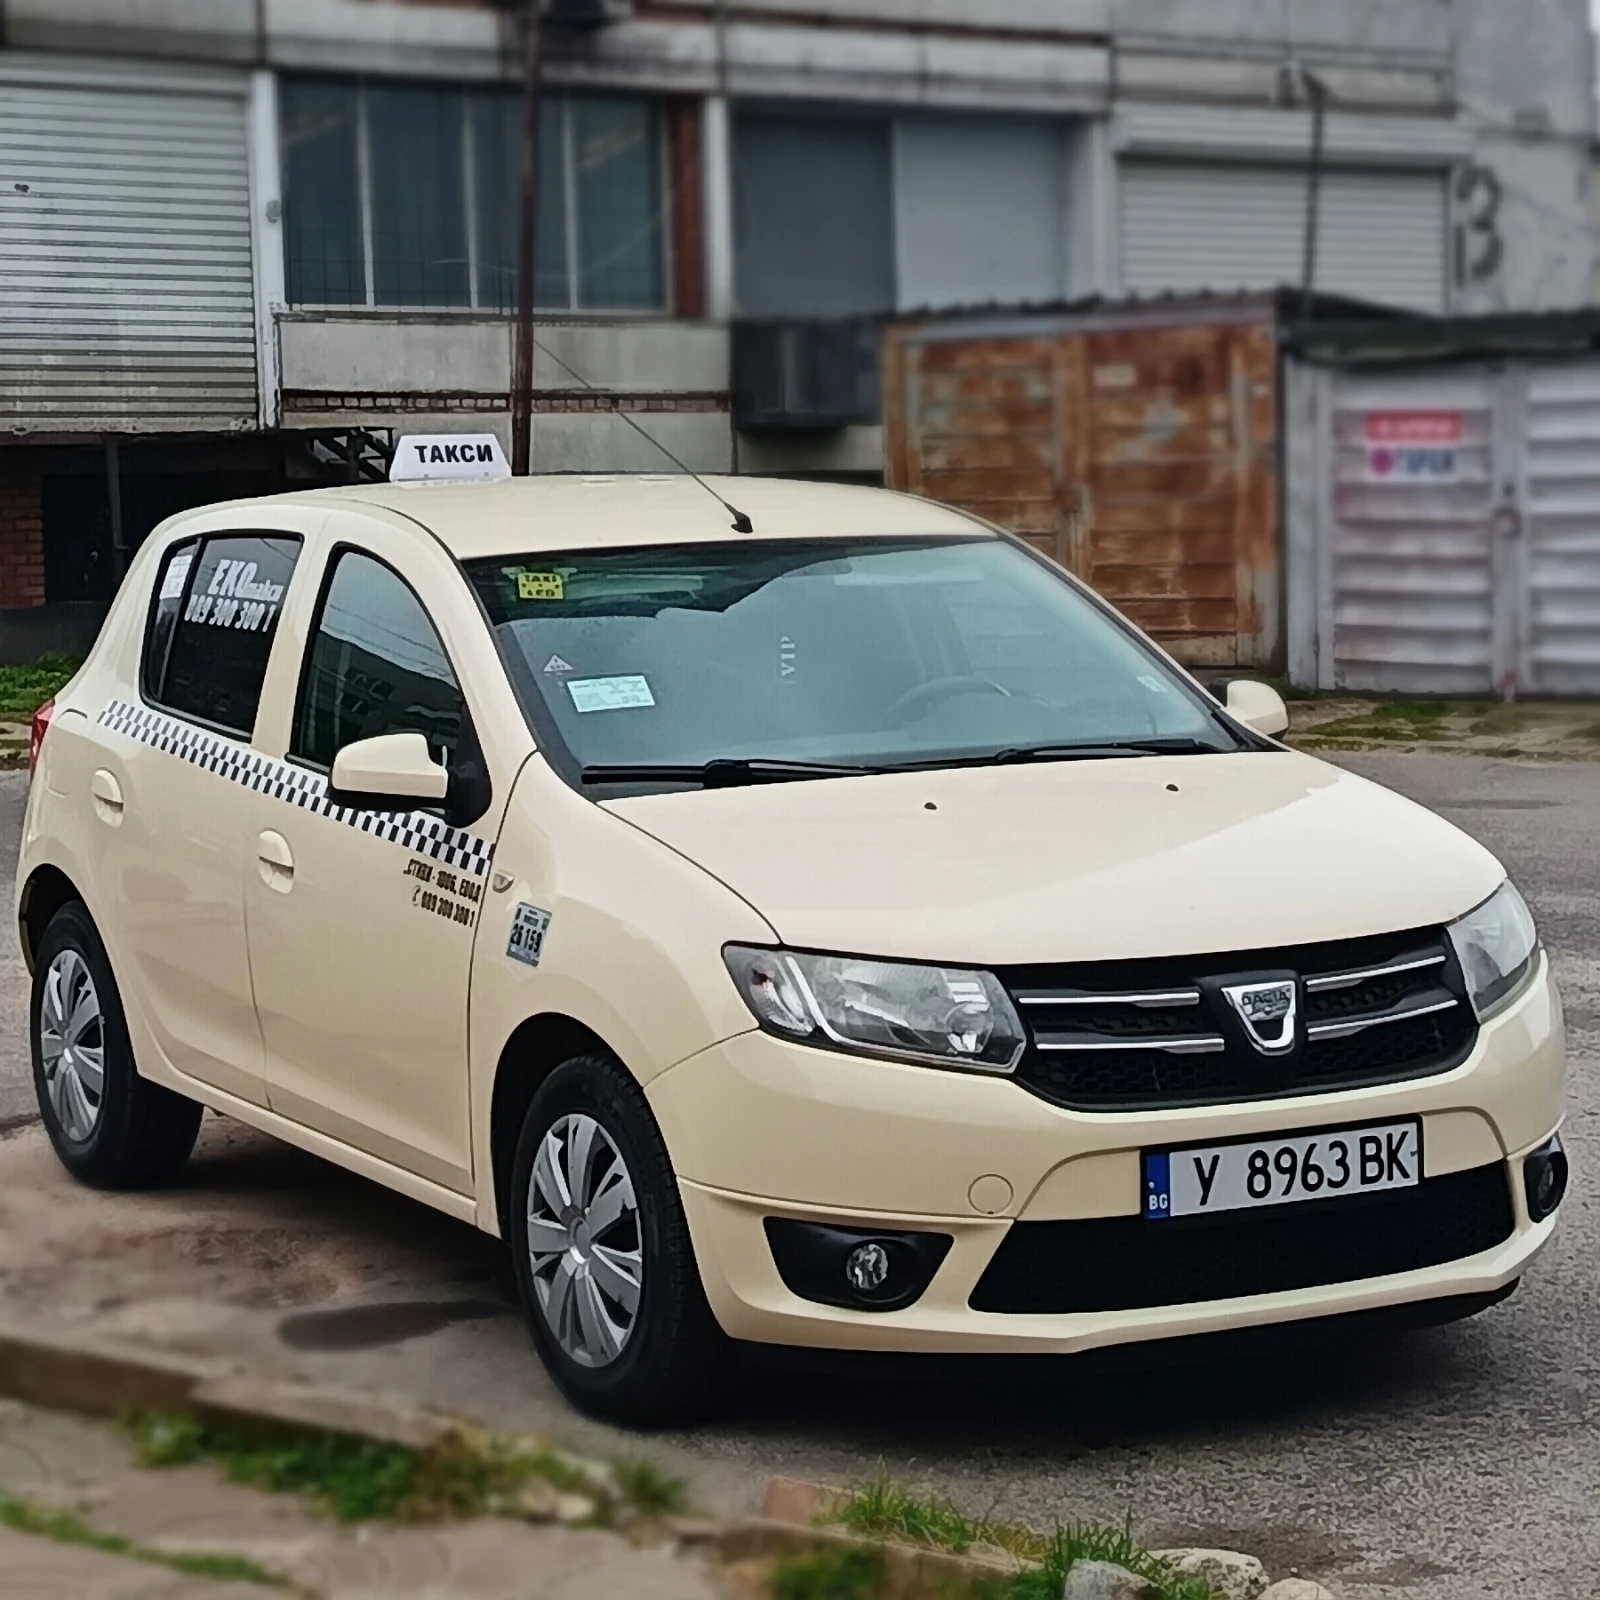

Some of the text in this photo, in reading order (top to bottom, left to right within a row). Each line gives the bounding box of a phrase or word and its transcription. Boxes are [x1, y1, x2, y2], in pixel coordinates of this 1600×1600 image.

[413, 444, 493, 463] ТАКСИ
[1241, 988, 1291, 1006] DACIA
[1149, 1194, 1168, 1210] BG
